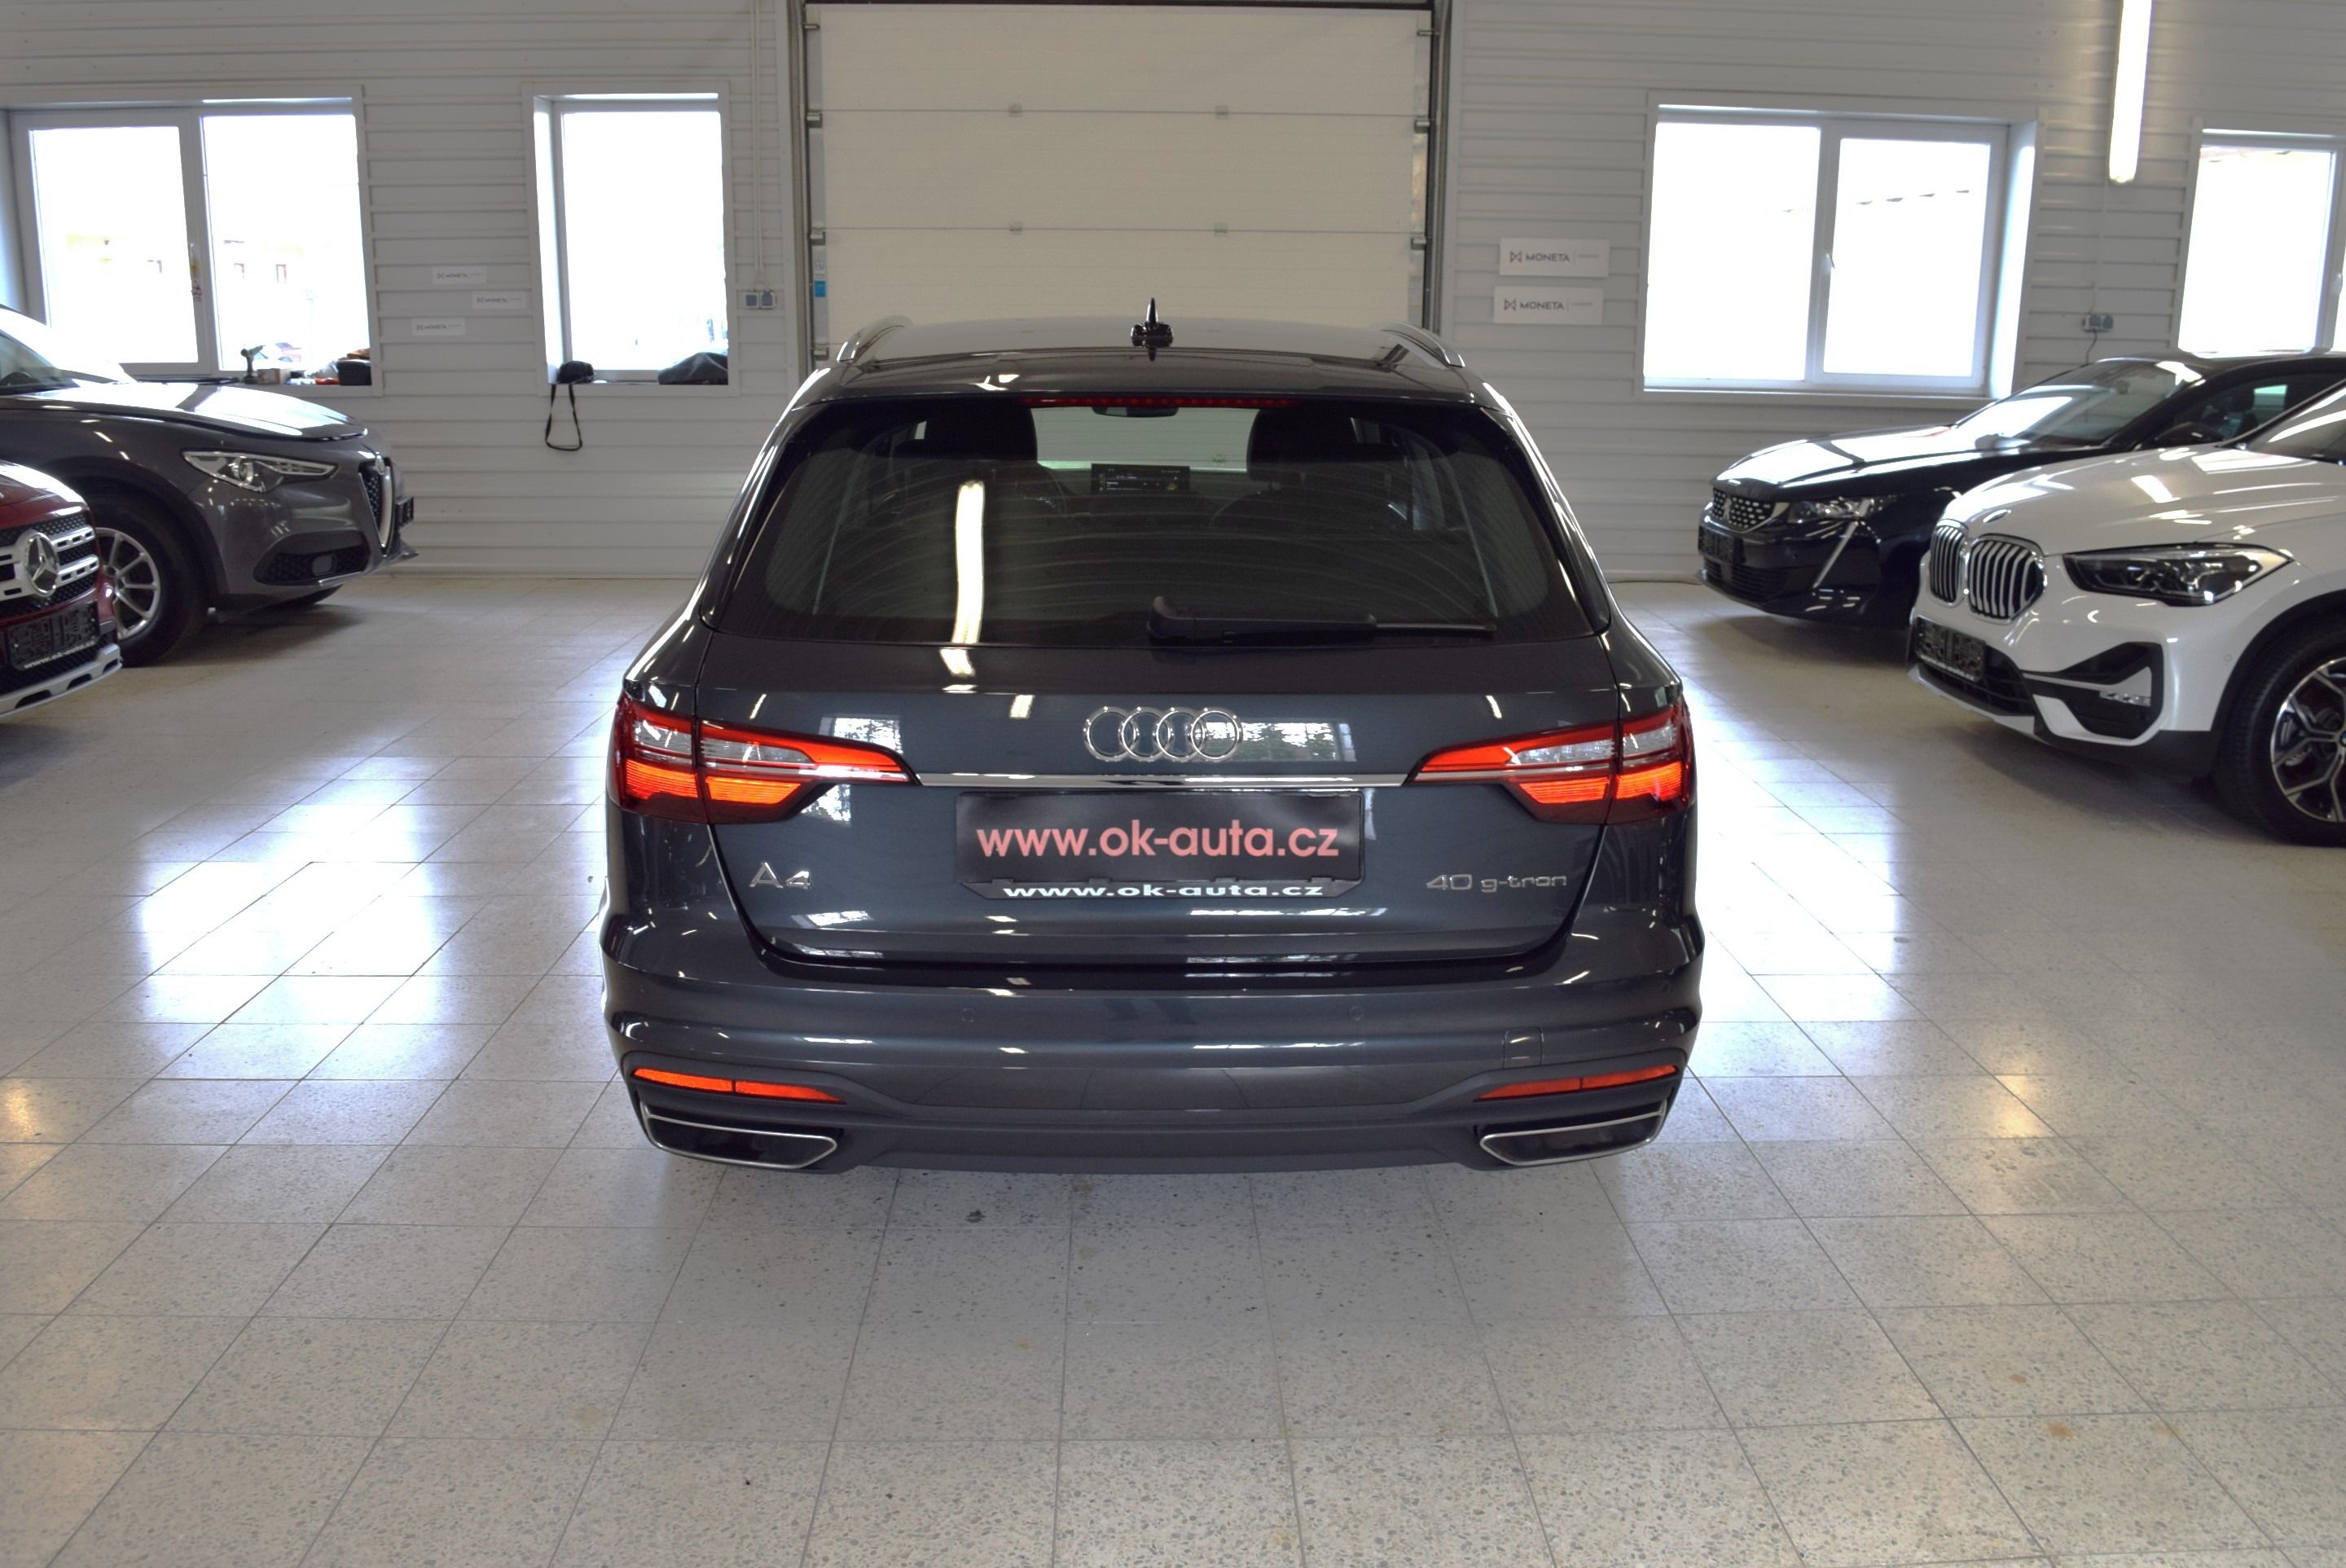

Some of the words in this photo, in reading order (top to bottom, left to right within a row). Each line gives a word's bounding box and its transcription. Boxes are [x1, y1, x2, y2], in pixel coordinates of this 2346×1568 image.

[1526, 253, 1571, 262] MONETA
[1519, 301, 1564, 310] MONETA
[977, 819, 1339, 857] www.ok-auta.cz
[749, 861, 811, 889] A4
[1003, 884, 1324, 897] www.ok-auta.cz
[1426, 874, 1473, 890] 40
[1481, 875, 1567, 893] g-tron
